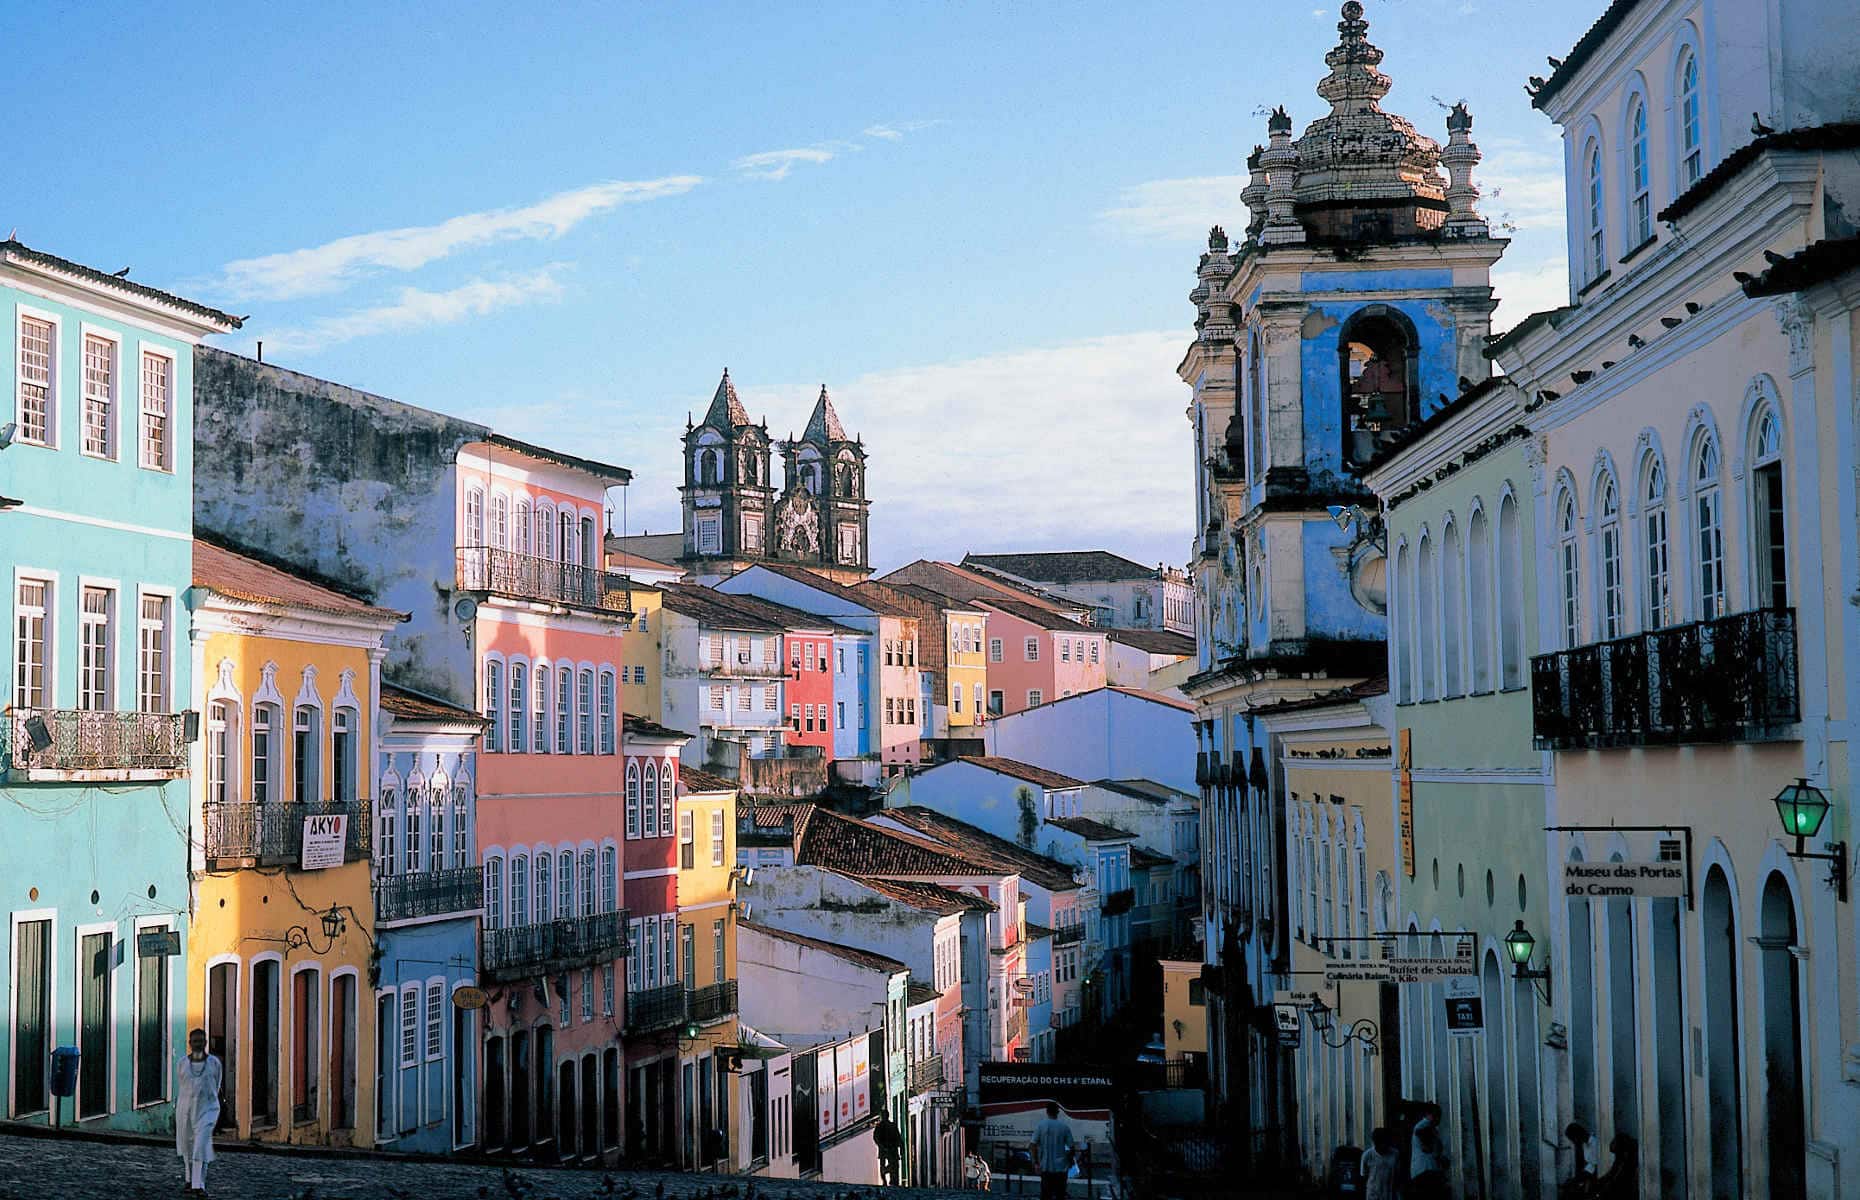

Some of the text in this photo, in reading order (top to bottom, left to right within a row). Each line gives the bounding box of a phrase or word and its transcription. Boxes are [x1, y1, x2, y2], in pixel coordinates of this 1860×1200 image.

[1566, 866, 1682, 878] Museu das Portas
[1566, 883, 1634, 895] do Carmo
[1389, 965, 1473, 975] Buffet de Saladas
[1326, 972, 1363, 980] Culinária
[1399, 975, 1418, 983] Kilo
[1290, 991, 1306, 1000] Loja
[981, 1075, 1038, 1085] RECUPERAÇÃO
[1040, 1076, 1052, 1084] DO
